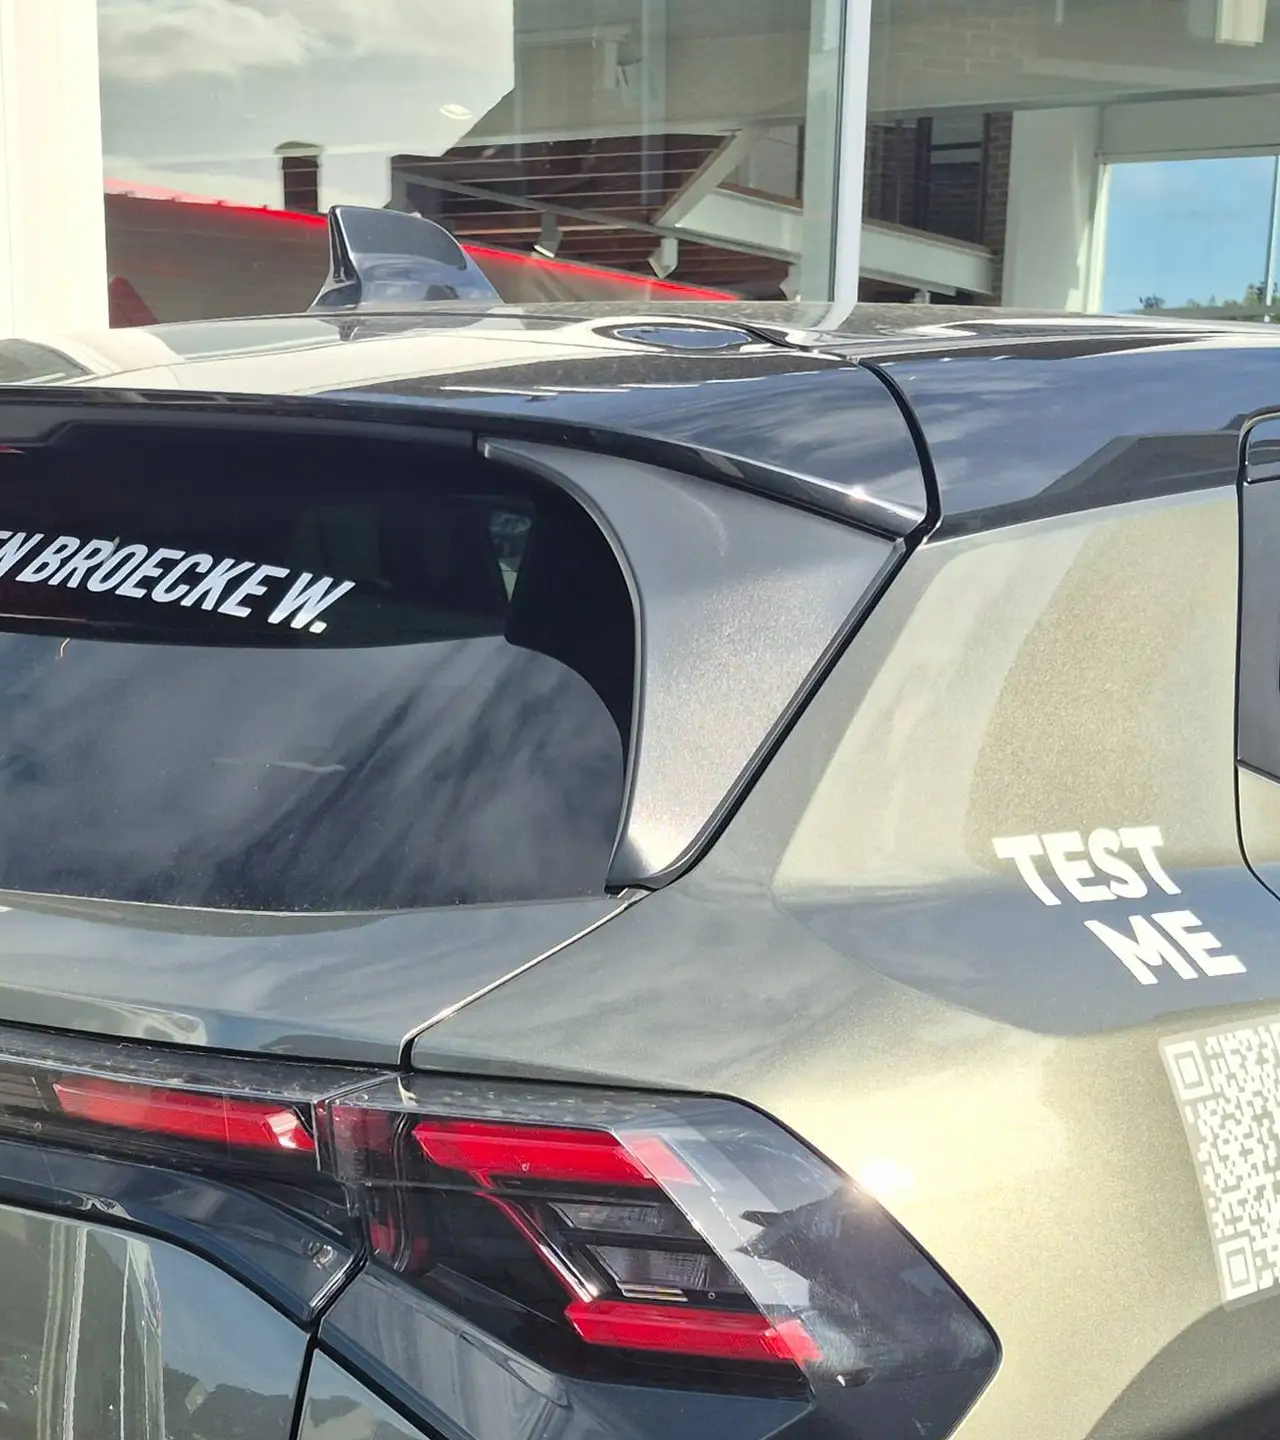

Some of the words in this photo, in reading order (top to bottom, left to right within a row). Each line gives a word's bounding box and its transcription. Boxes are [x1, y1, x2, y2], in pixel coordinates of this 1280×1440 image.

[15, 536, 291, 618] BROECKE
[266, 571, 357, 634] W.
[991, 825, 1182, 906] TEST
[1083, 910, 1247, 986] ME
